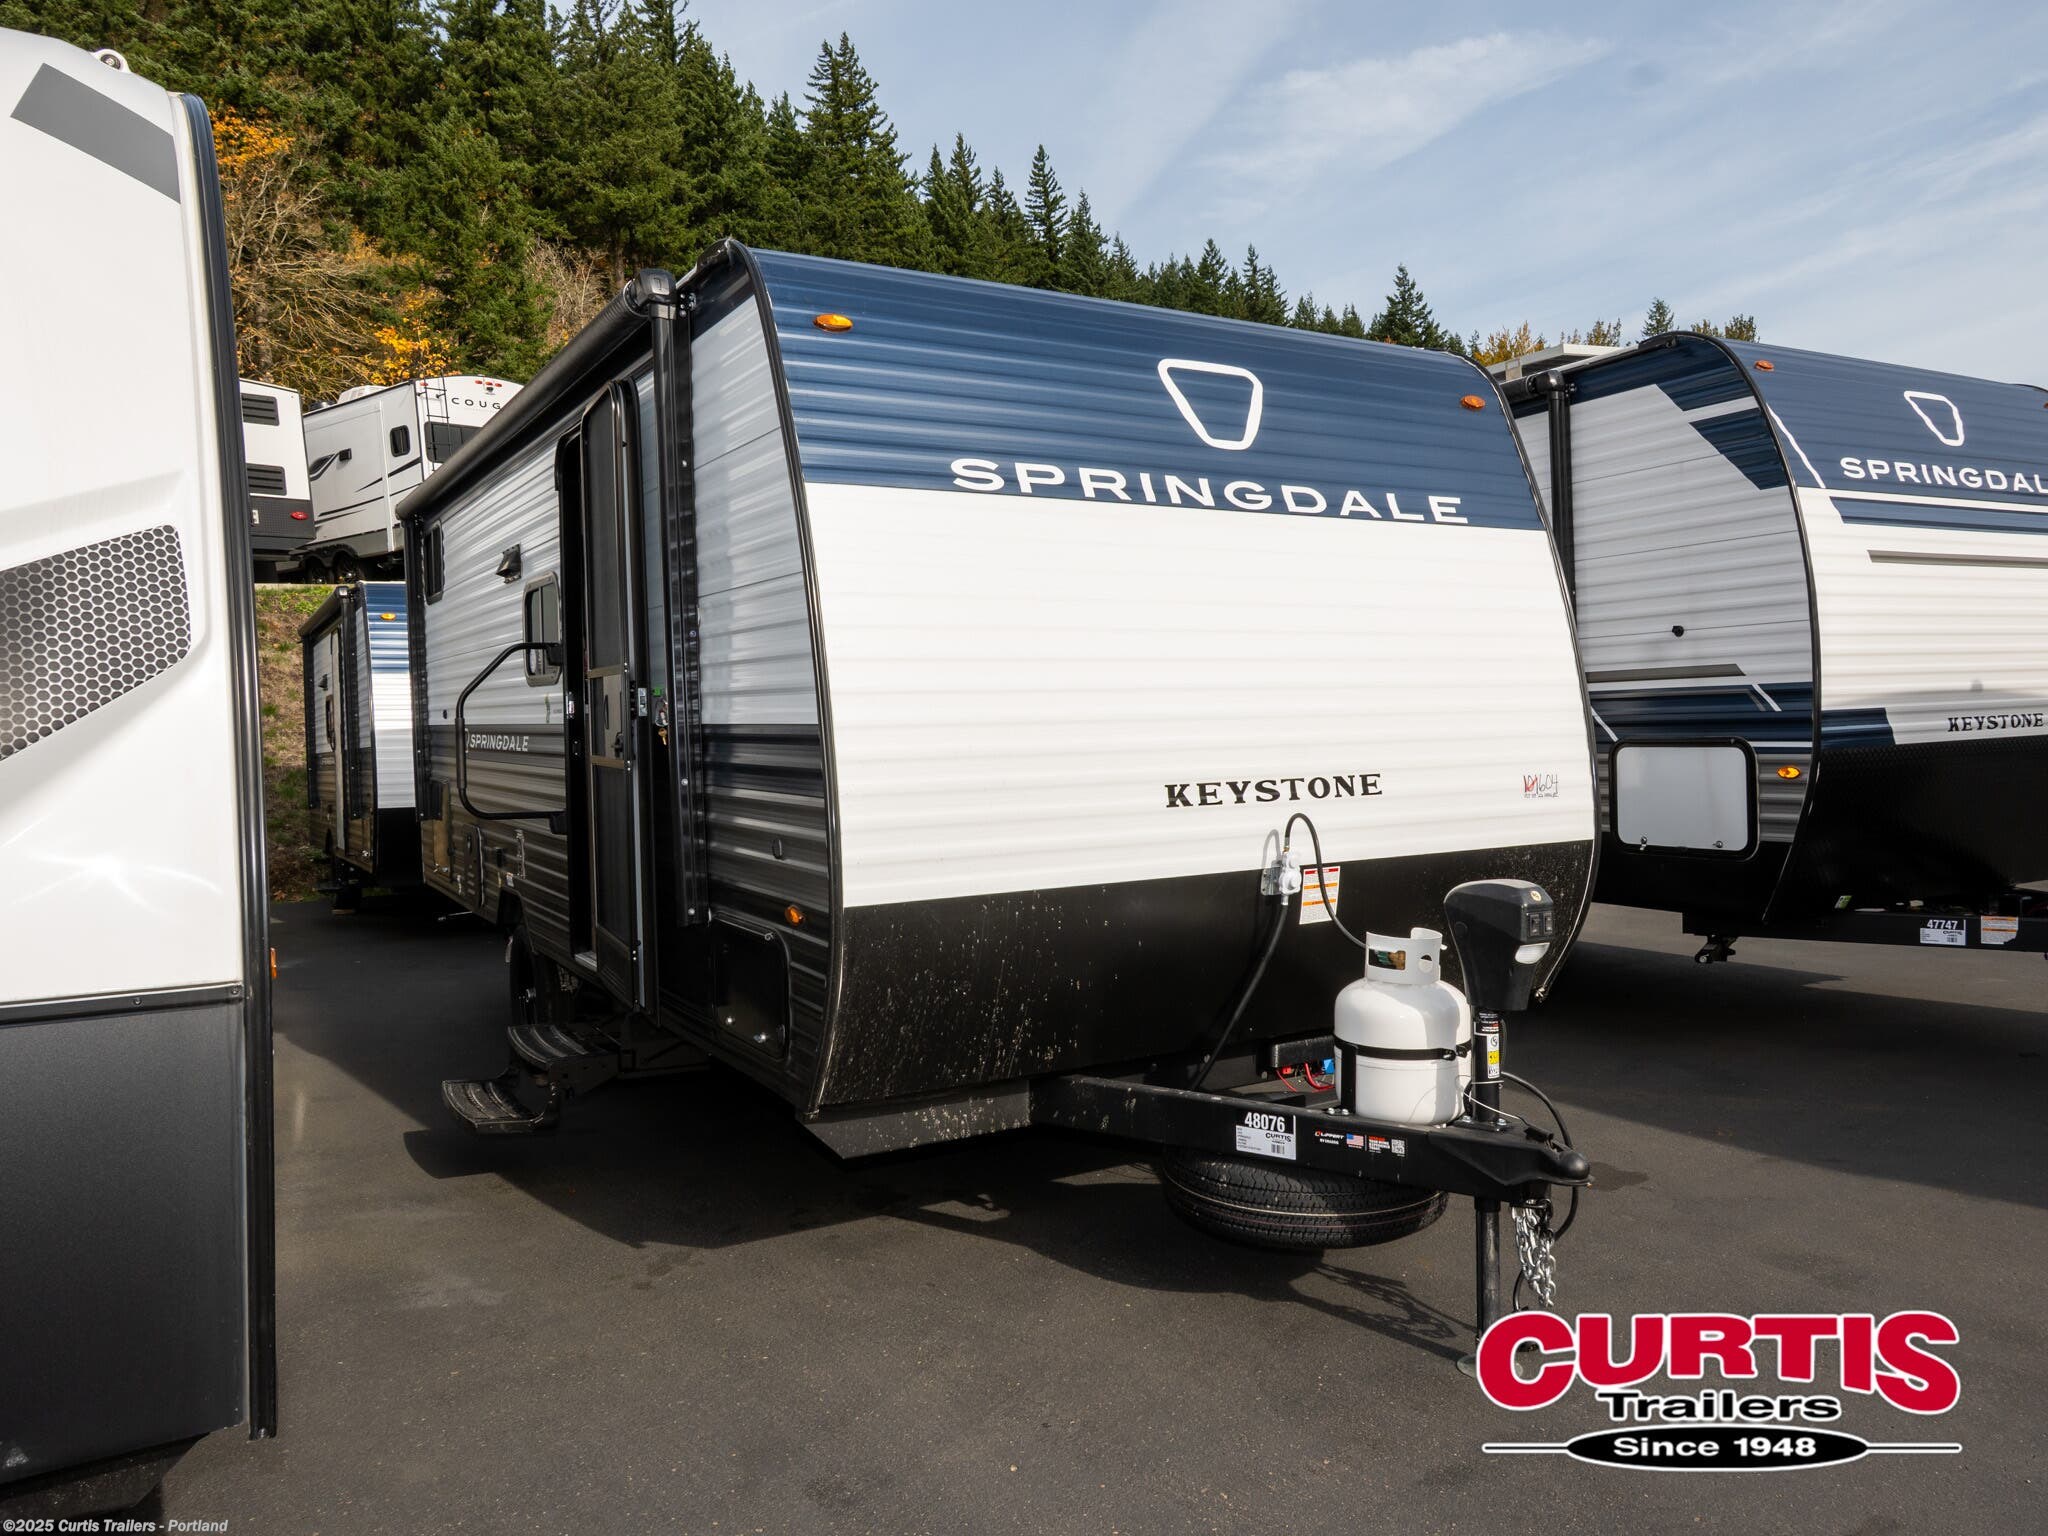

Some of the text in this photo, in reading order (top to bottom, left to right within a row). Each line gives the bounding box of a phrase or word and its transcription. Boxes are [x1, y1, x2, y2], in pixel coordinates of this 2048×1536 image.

[950, 457, 1469, 525] SPRINGDALE
[1946, 712, 2045, 733] KEYSTONE
[469, 733, 530, 752] SPRINGDALE
[1164, 773, 1383, 808] KEYSTONE
[1926, 919, 1959, 930] 47747
[1244, 1111, 1286, 1133] 48076
[1265, 1132, 1292, 1143] CURTIS
